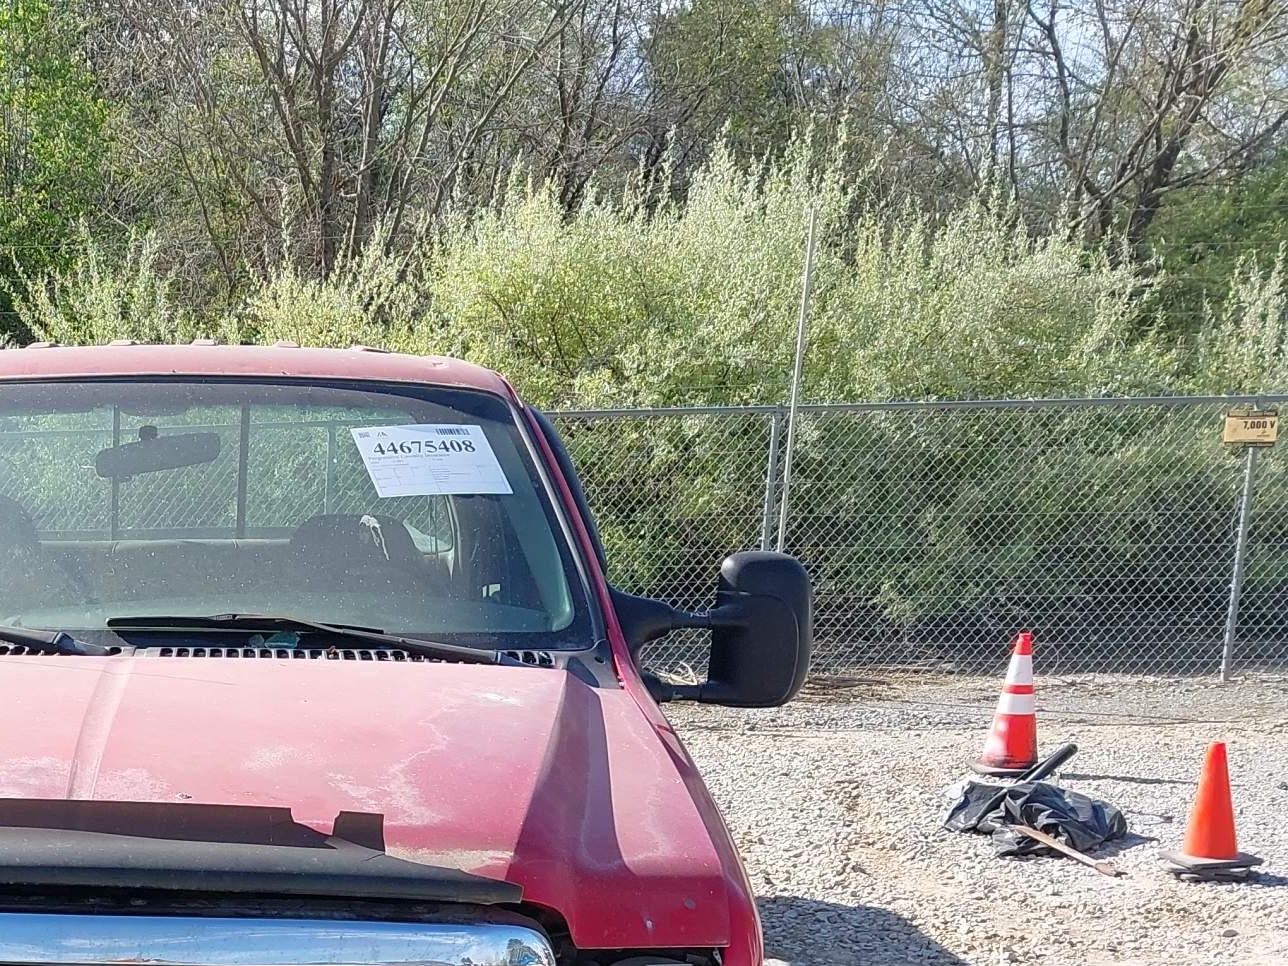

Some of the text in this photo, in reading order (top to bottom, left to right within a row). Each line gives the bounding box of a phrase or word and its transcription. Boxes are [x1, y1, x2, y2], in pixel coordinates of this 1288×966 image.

[1243, 421, 1276, 430] 7,000 V
[372, 439, 476, 455] 44675408
